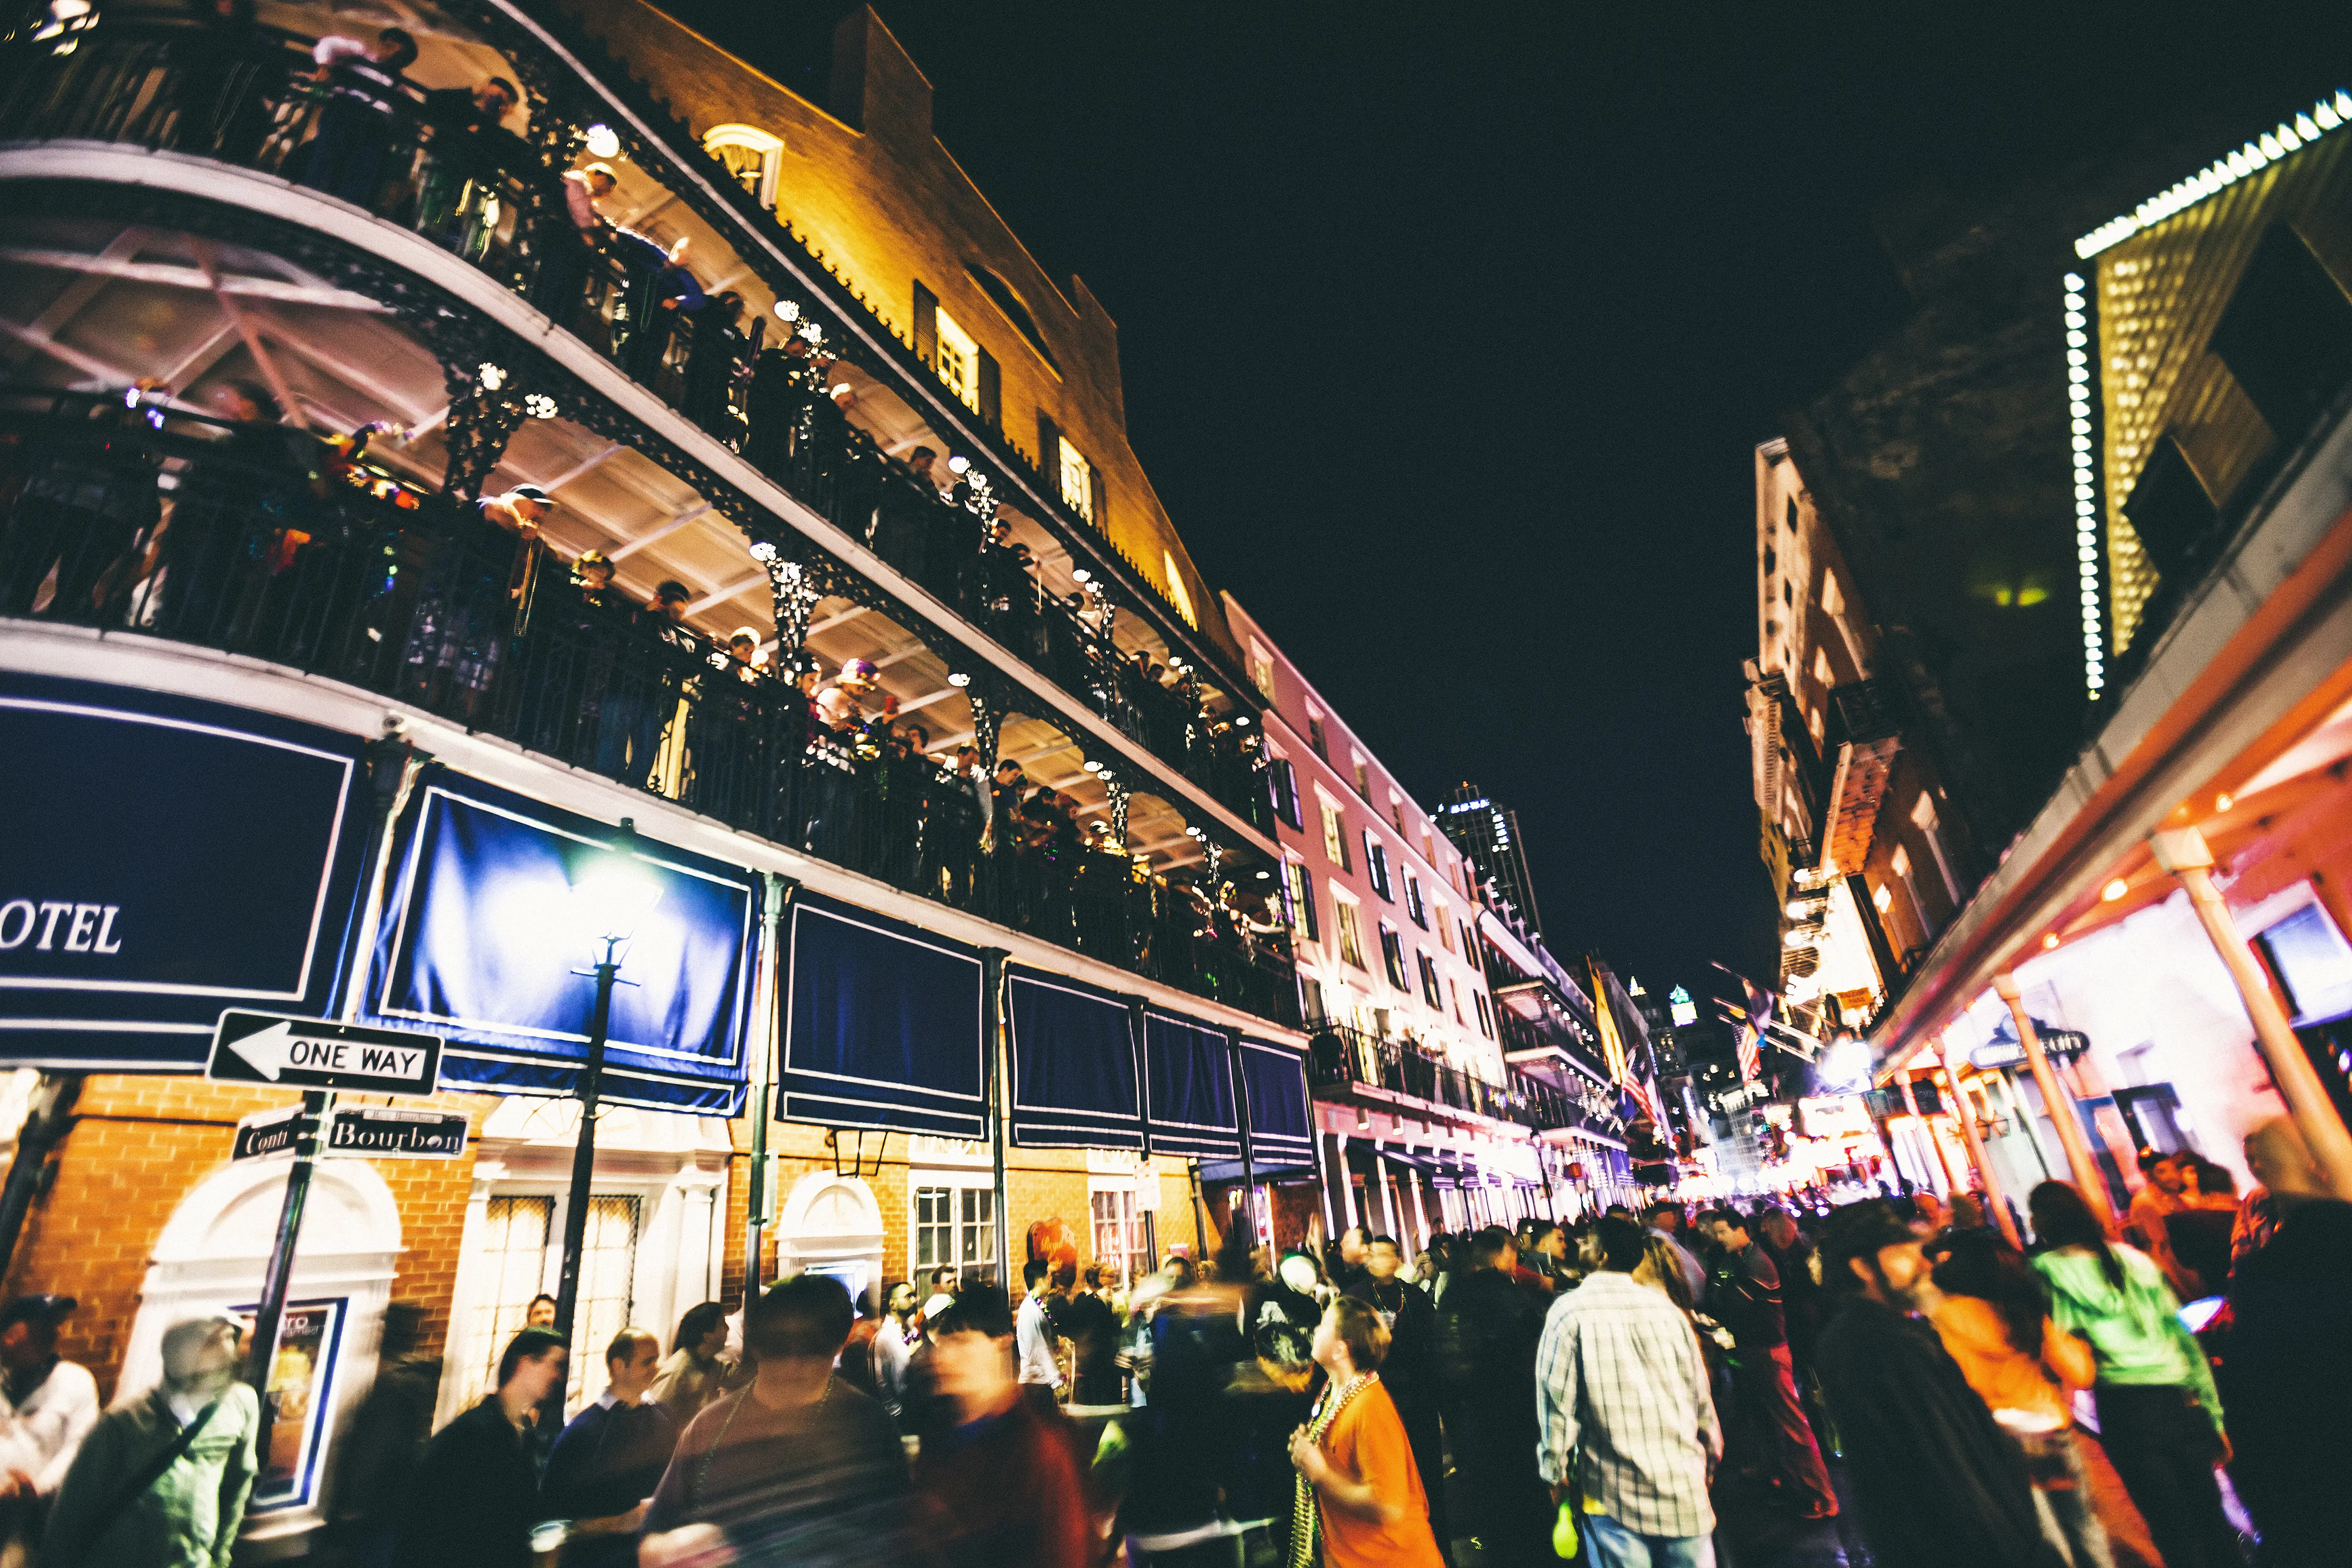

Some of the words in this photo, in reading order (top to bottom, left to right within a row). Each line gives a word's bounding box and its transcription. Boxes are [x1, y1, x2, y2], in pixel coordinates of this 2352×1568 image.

[0, 899, 122, 954] OTEL
[290, 1040, 349, 1069] ONE
[362, 1048, 418, 1075] WAY
[246, 1123, 290, 1154] Conti
[335, 1122, 460, 1150] Bourbon
